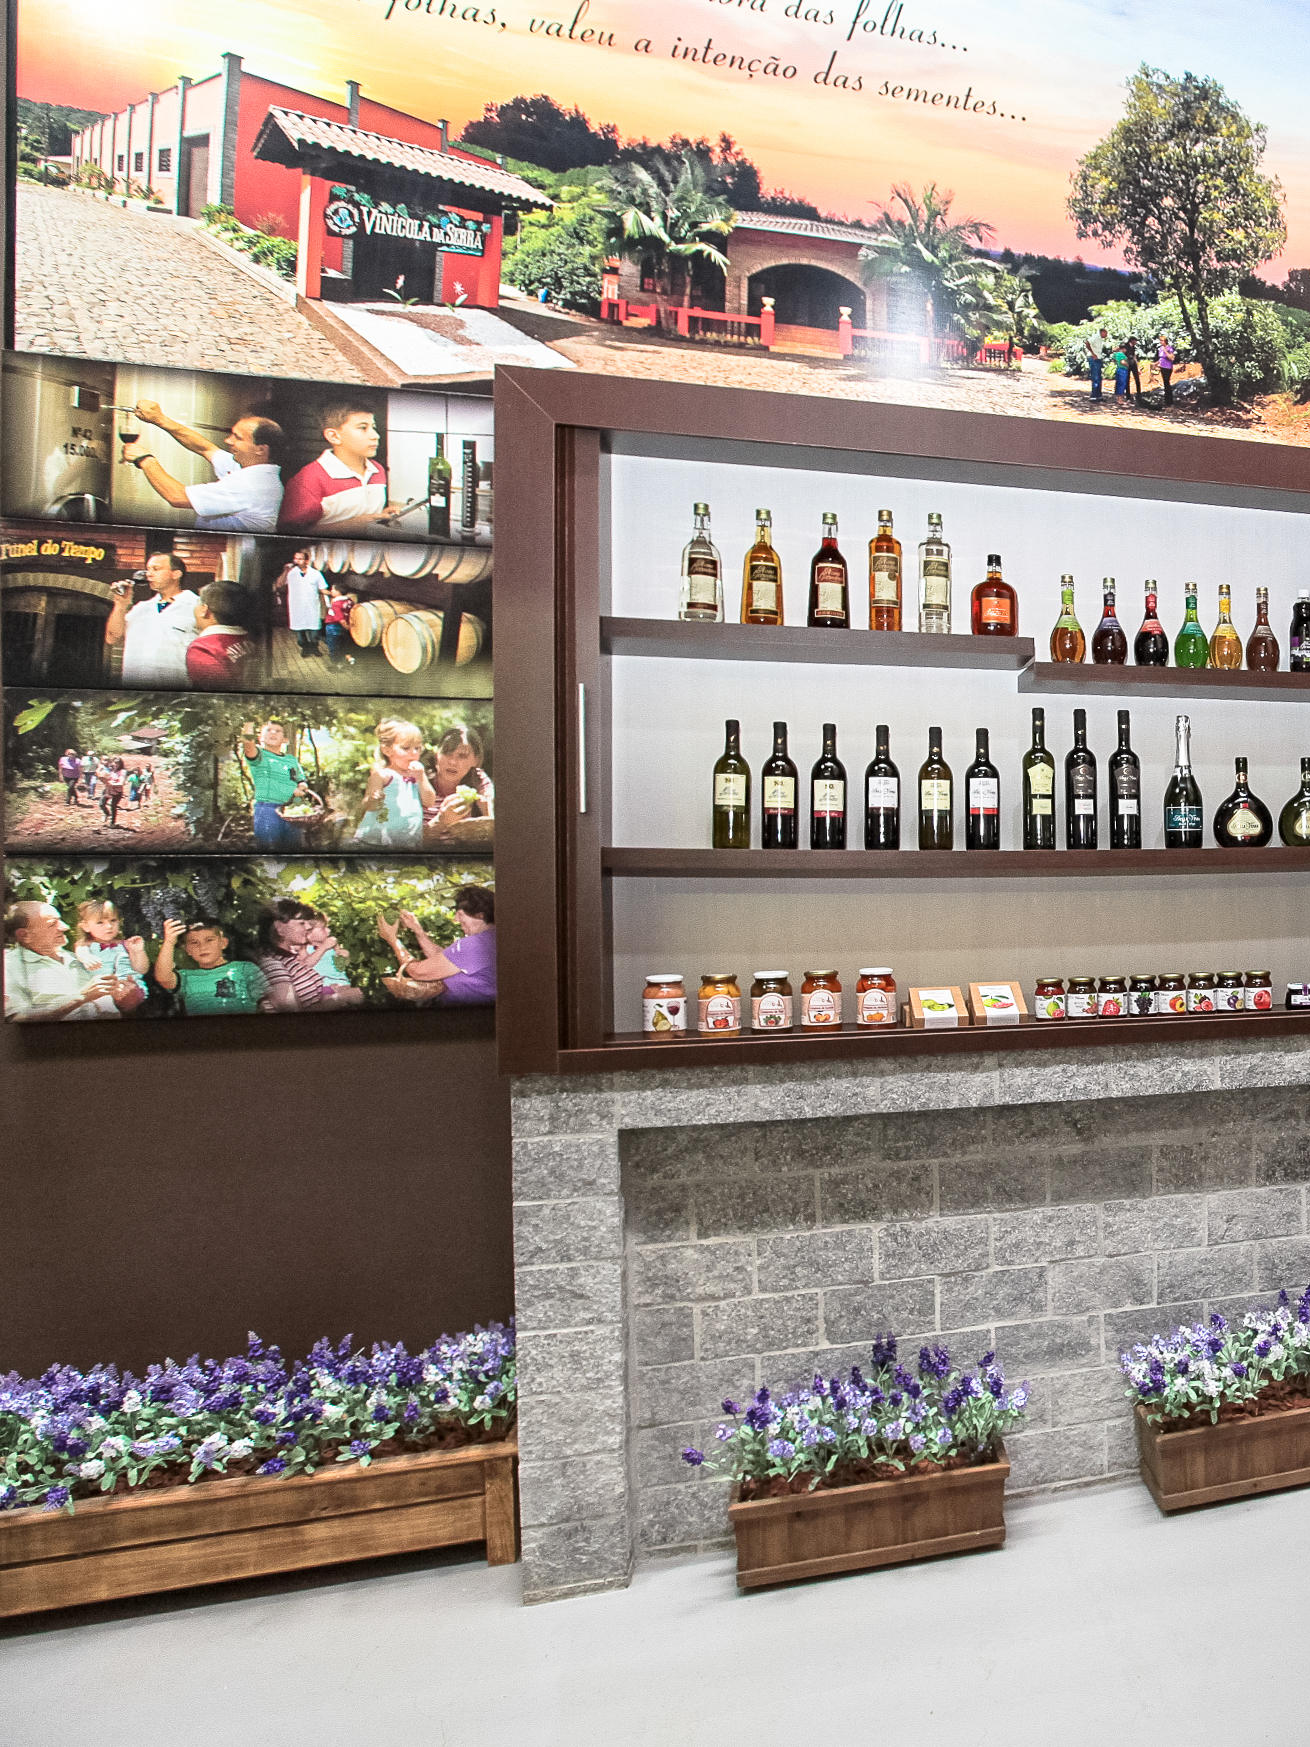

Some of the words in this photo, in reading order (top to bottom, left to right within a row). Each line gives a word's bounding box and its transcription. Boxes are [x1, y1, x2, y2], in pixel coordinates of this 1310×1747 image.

[846, 0, 968, 52] folhas...
[529, 0, 617, 47] valeu
[633, 37, 654, 54] a
[671, 36, 798, 80] intenção
[813, 50, 864, 92] das
[877, 80, 1027, 122] sementes...
[432, 226, 447, 244] DA
[446, 223, 484, 250] SERRA
[40, 539, 60, 556] do
[61, 540, 105, 564] Tempo
